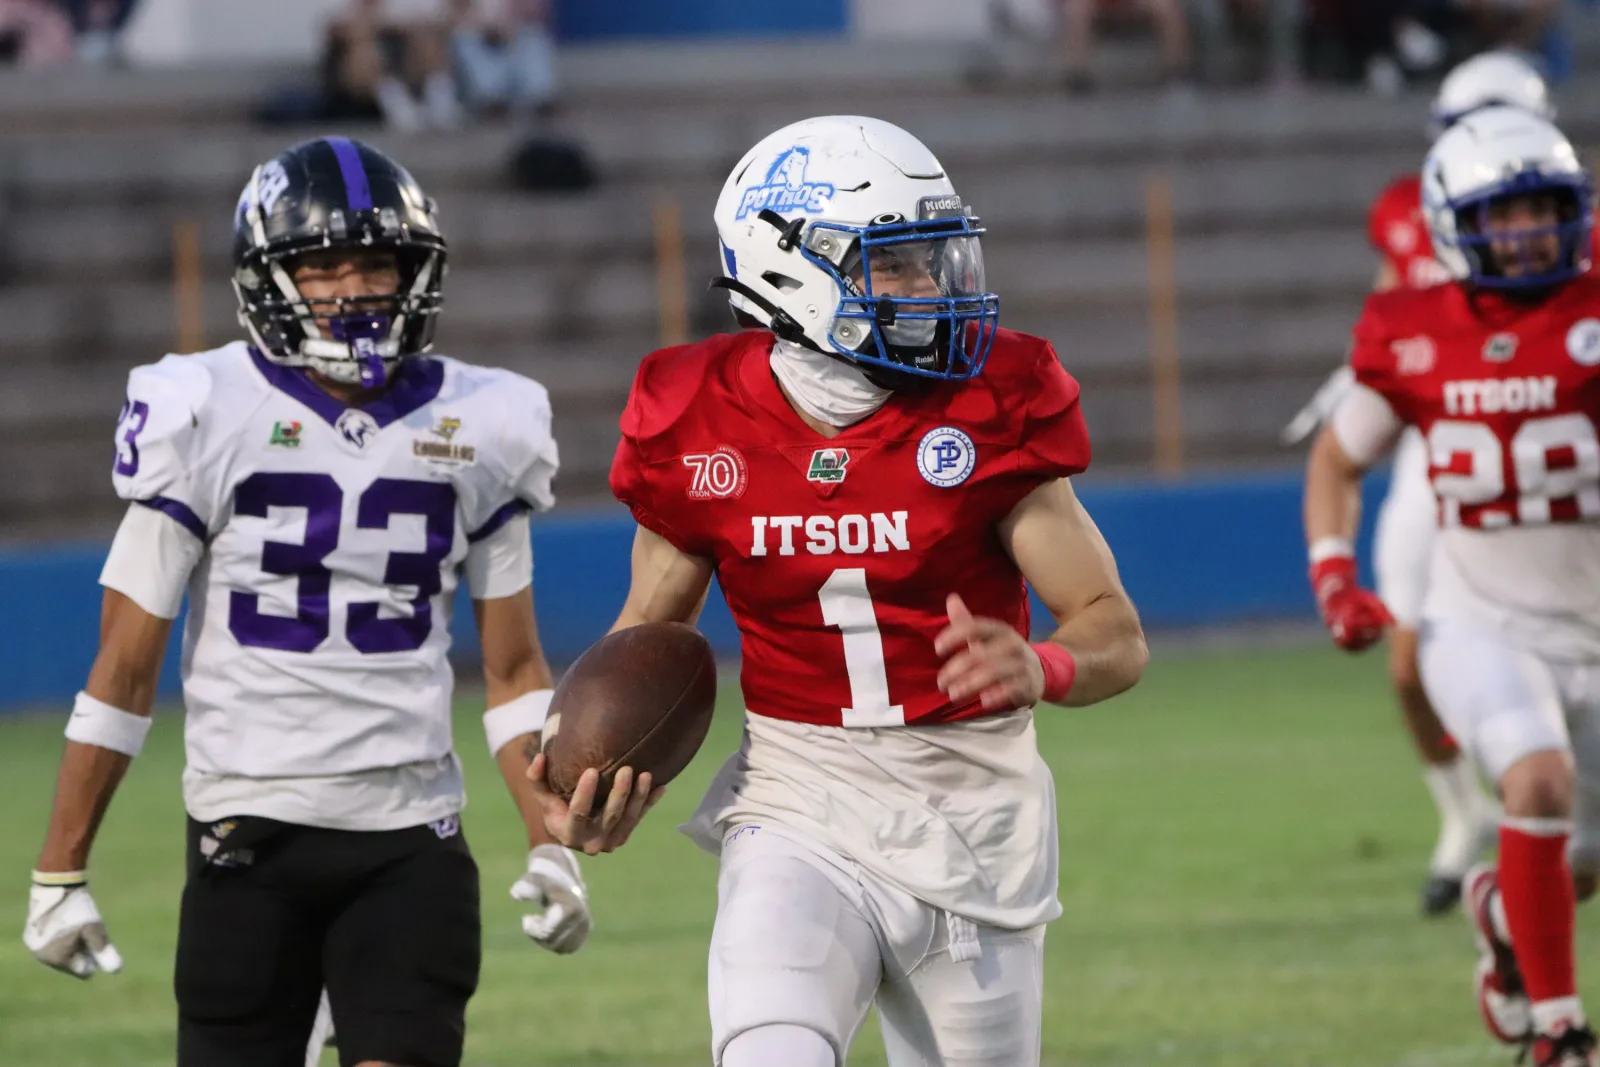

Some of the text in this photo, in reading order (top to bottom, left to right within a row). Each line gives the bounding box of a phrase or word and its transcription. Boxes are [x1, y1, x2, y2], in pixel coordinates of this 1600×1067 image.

[924, 198, 962, 211] Riddell
[1443, 375, 1558, 415] ITSON
[683, 453, 738, 496] 70
[1429, 414, 1600, 528] 28
[688, 490, 711, 498] ITSON
[750, 510, 911, 557] ITSON
[229, 472, 456, 653] 33
[818, 567, 906, 728] 1
